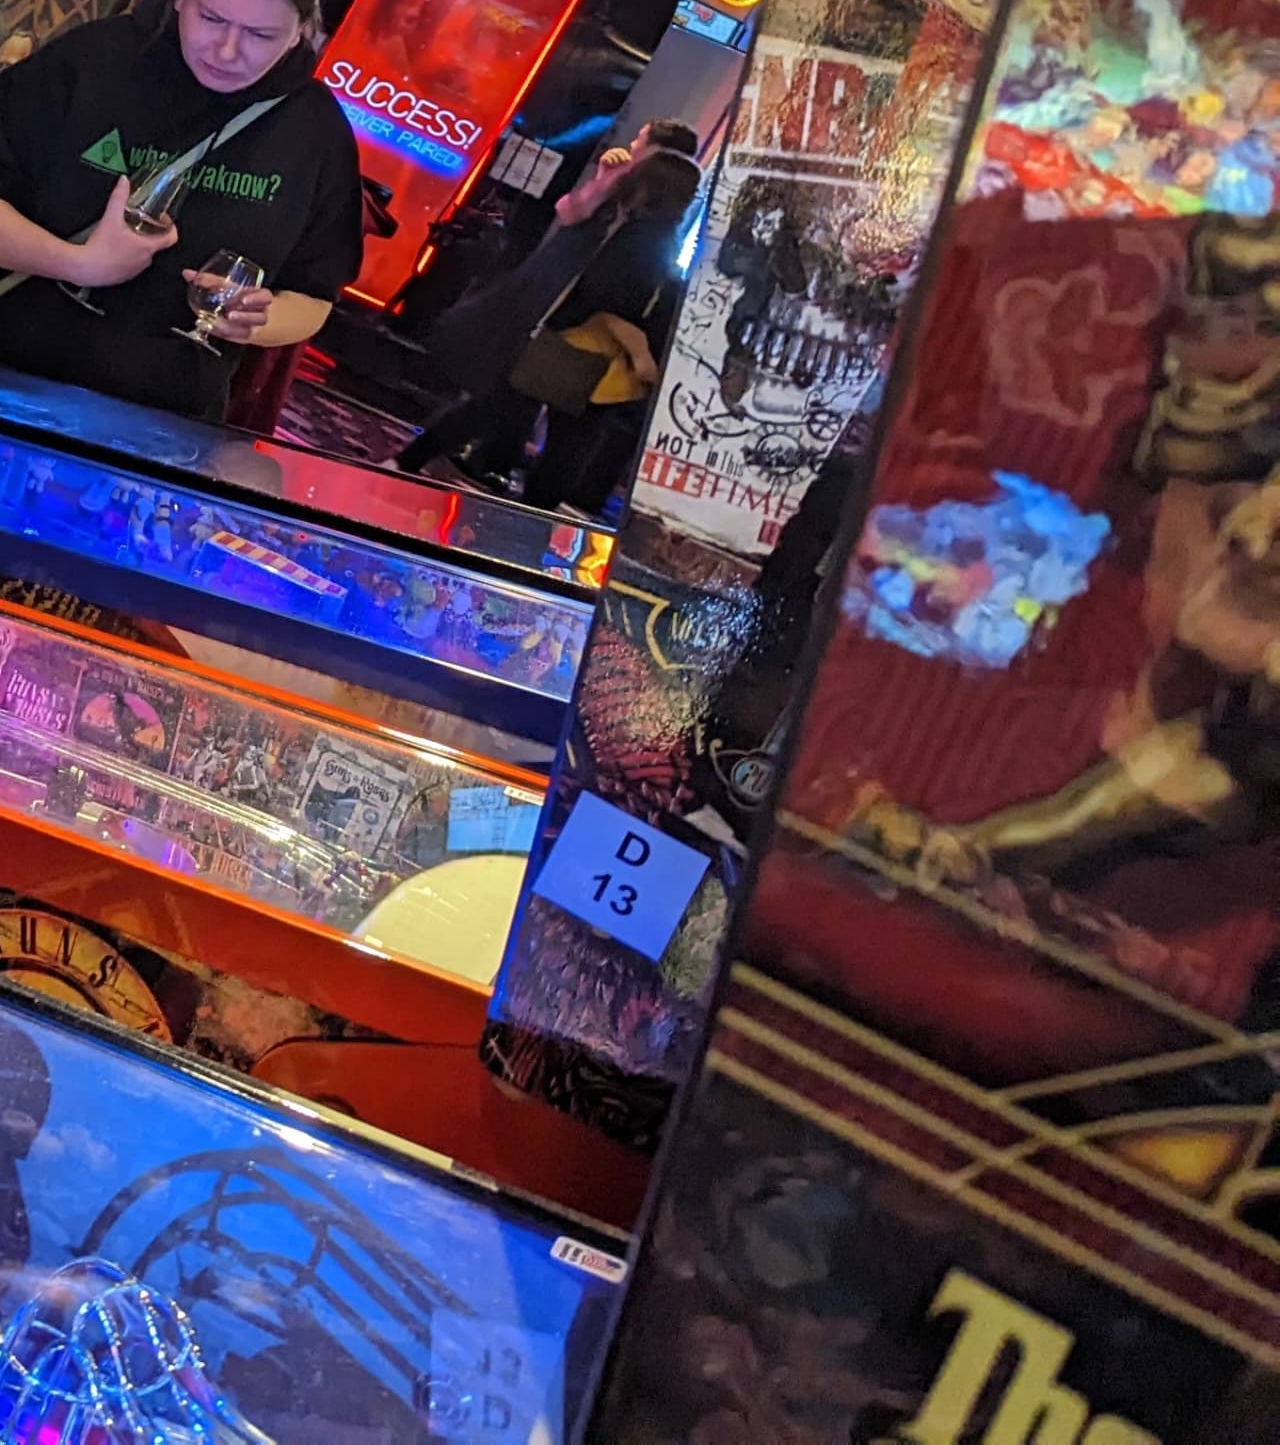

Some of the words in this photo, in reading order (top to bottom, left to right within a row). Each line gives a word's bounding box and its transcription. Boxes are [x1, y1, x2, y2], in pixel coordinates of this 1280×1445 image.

[323, 61, 483, 151] SUCCESS!
[615, 830, 652, 868] D
[591, 872, 640, 917] 13
